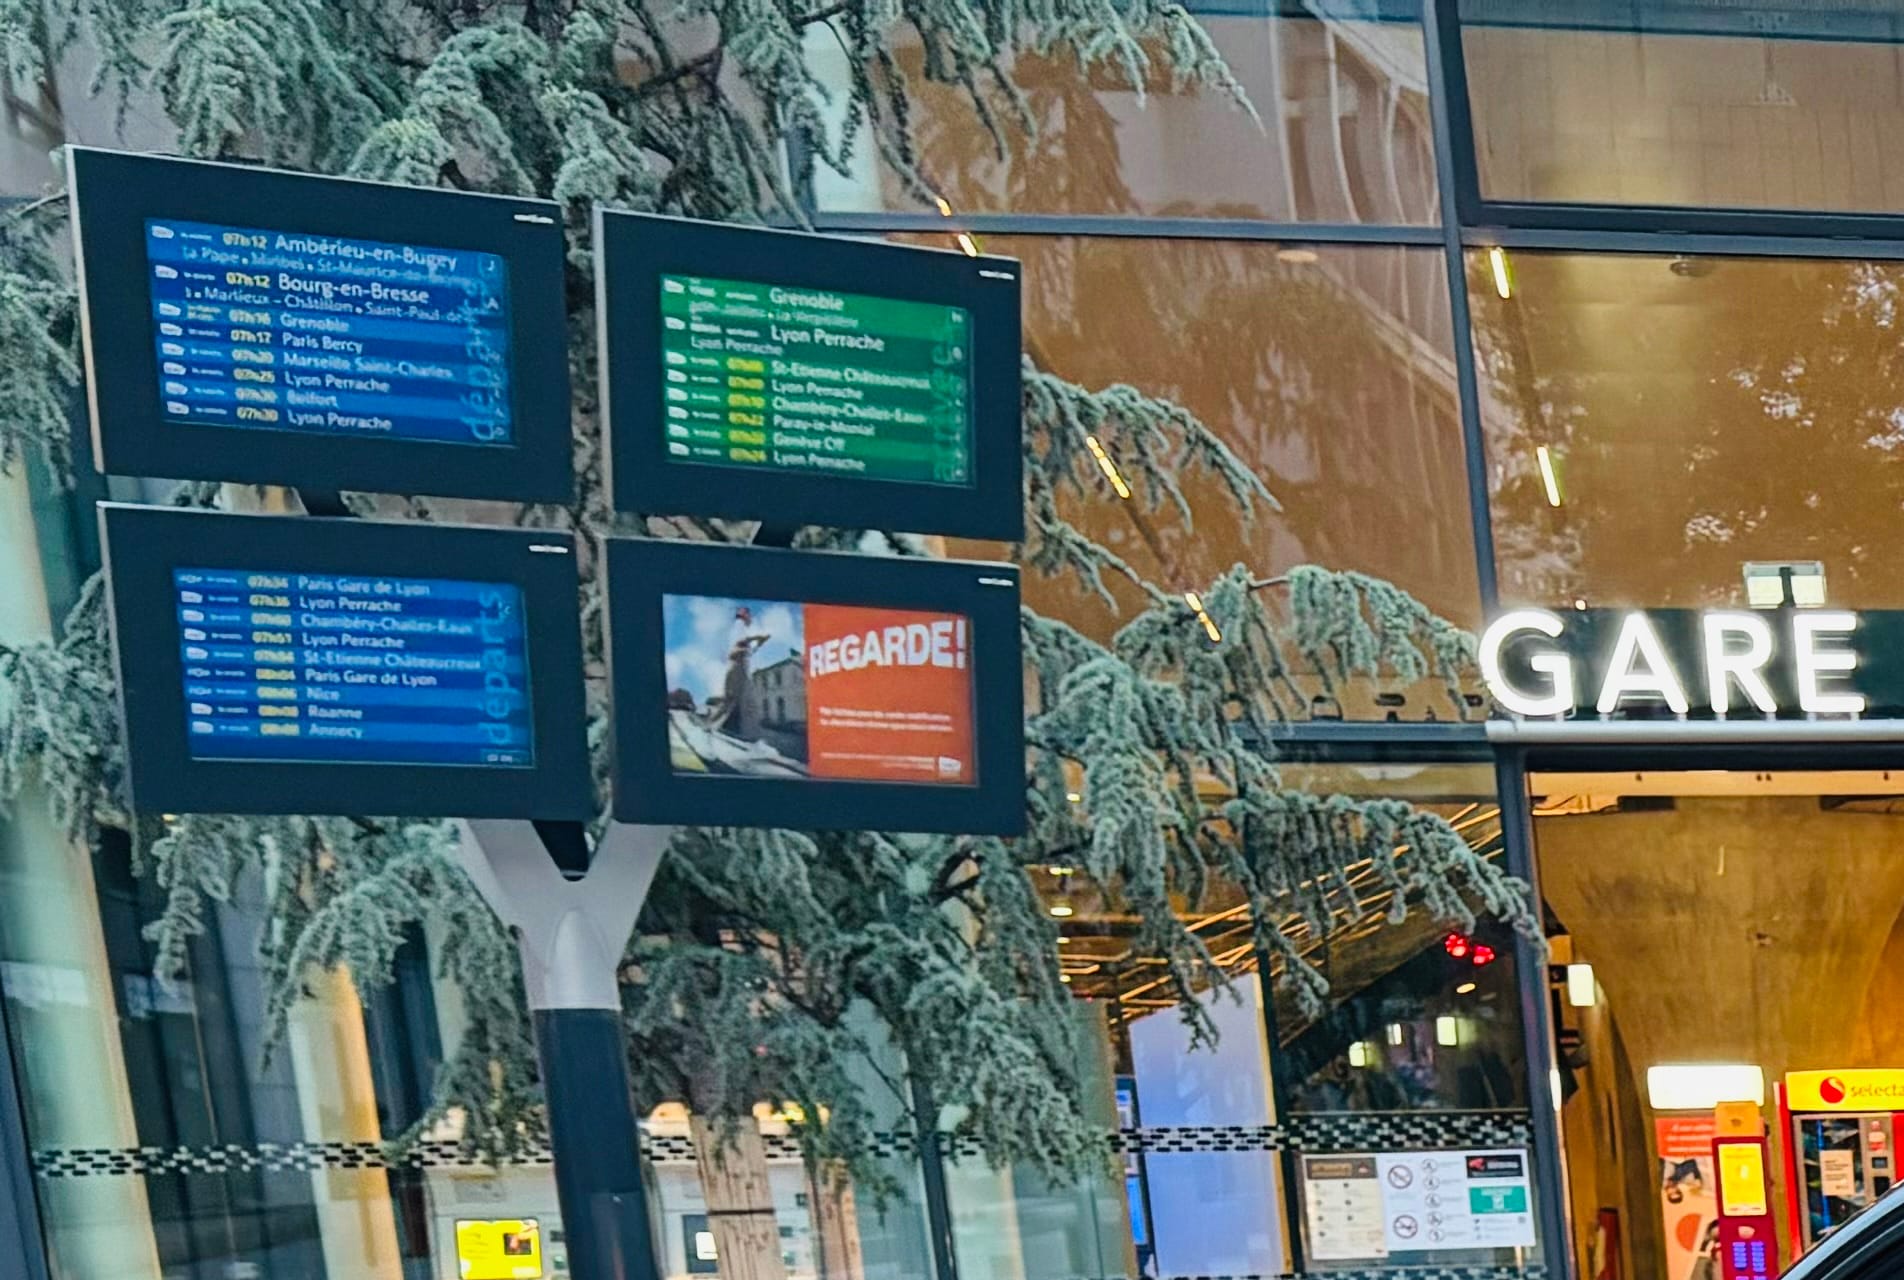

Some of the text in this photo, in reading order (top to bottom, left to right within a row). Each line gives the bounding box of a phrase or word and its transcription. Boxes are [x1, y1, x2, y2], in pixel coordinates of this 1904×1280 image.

[275, 234, 457, 274] Ambérieu-en-Bugey
[278, 272, 430, 304] Bourg-en-Bresse
[769, 287, 845, 311] Grenoble
[279, 311, 350, 333] Grenoble
[282, 332, 319, 349] Paris
[322, 336, 363, 355] Bercy
[770, 323, 885, 352] Lyon Perrache
[283, 351, 351, 370] Marseille
[284, 370, 322, 389] Lyon
[325, 374, 391, 393] Perrache
[287, 409, 325, 427] Lyon
[327, 412, 393, 431] Perrache
[298, 575, 334, 592] Paris
[336, 578, 371, 594] Gare
[374, 578, 392, 594] de
[395, 581, 430, 598] Lyon
[299, 595, 336, 611] Lyon
[338, 596, 402, 613] Perrache
[302, 632, 339, 648] Lyon
[341, 633, 406, 649] Perrache
[809, 618, 966, 679] REGARDE!
[477, 591, 523, 745] départs
[1479, 611, 1864, 715] GARE
[305, 667, 341, 684] Paris
[343, 669, 378, 685] Gare
[380, 670, 398, 685] de
[401, 672, 437, 688] Lyon
[307, 704, 363, 719] Roanne
